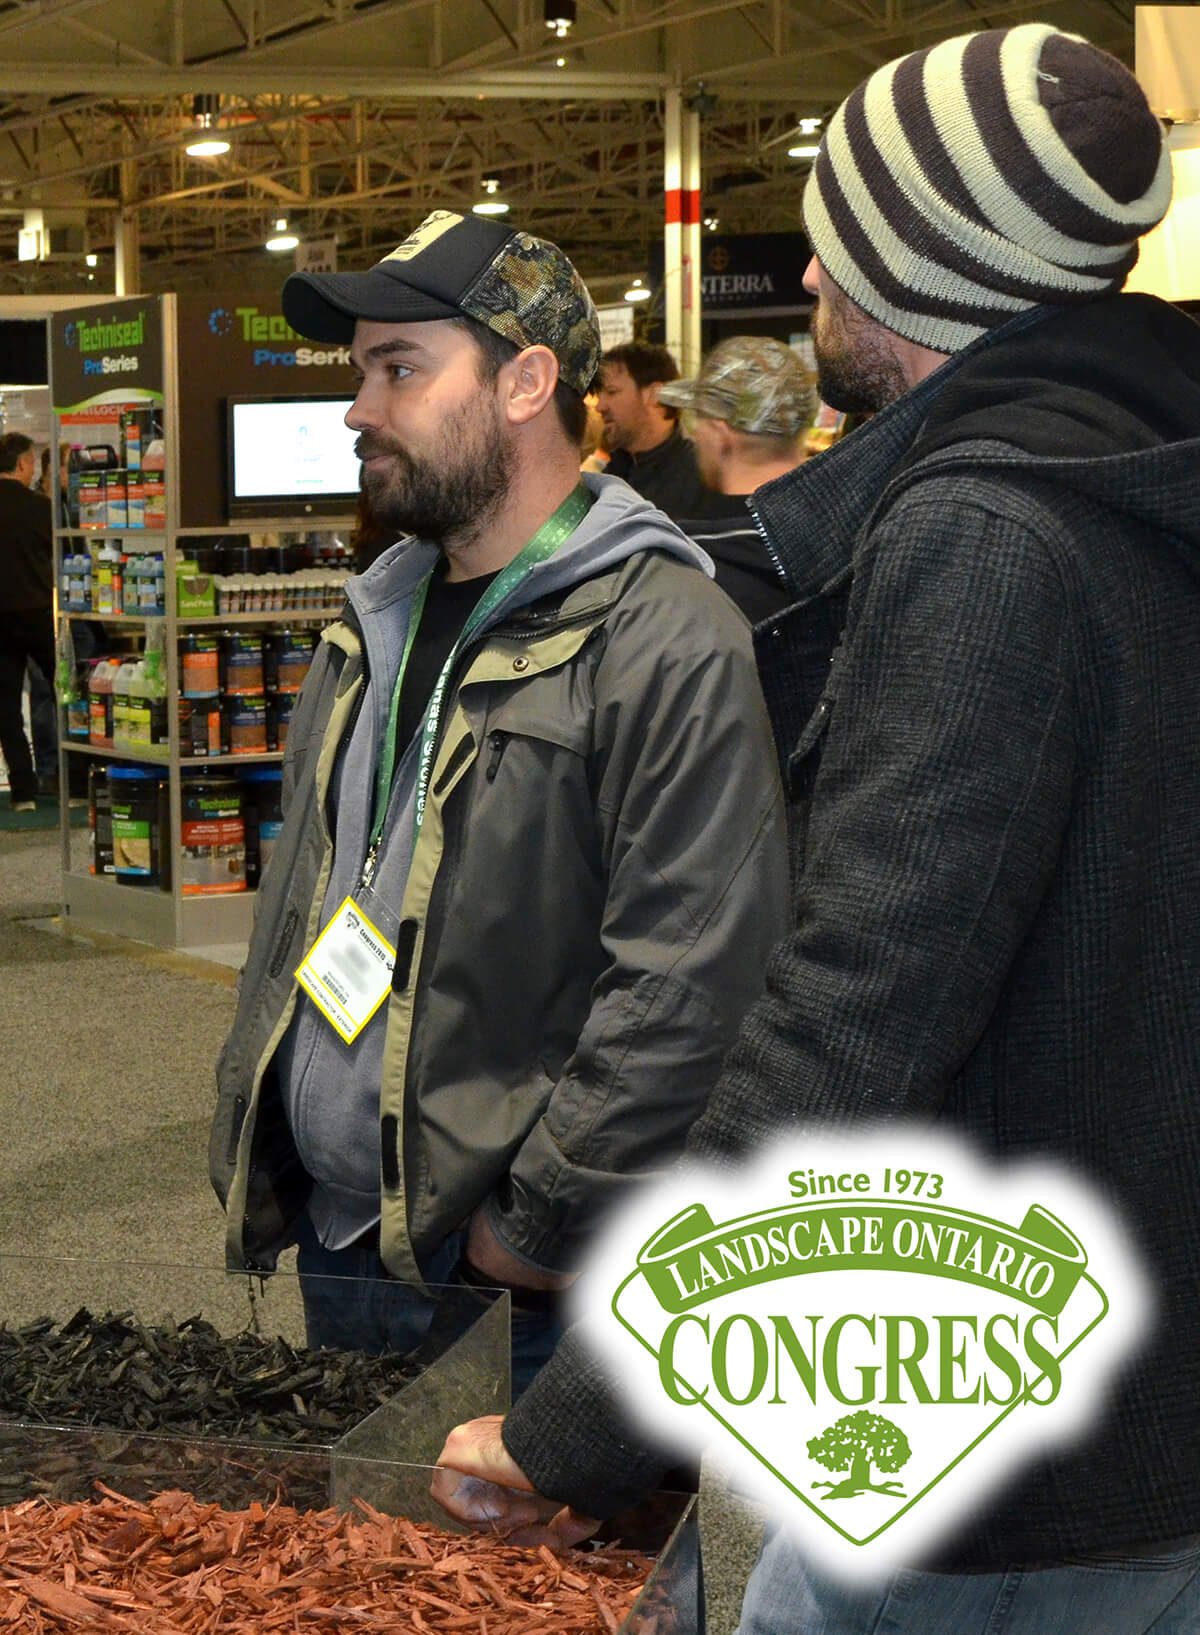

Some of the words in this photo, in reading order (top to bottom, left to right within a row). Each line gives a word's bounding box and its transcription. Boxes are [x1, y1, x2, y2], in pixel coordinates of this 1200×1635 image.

[76, 312, 144, 352] Techniseal
[84, 354, 139, 375] ProSeries
[360, 929, 377, 950] Congress
